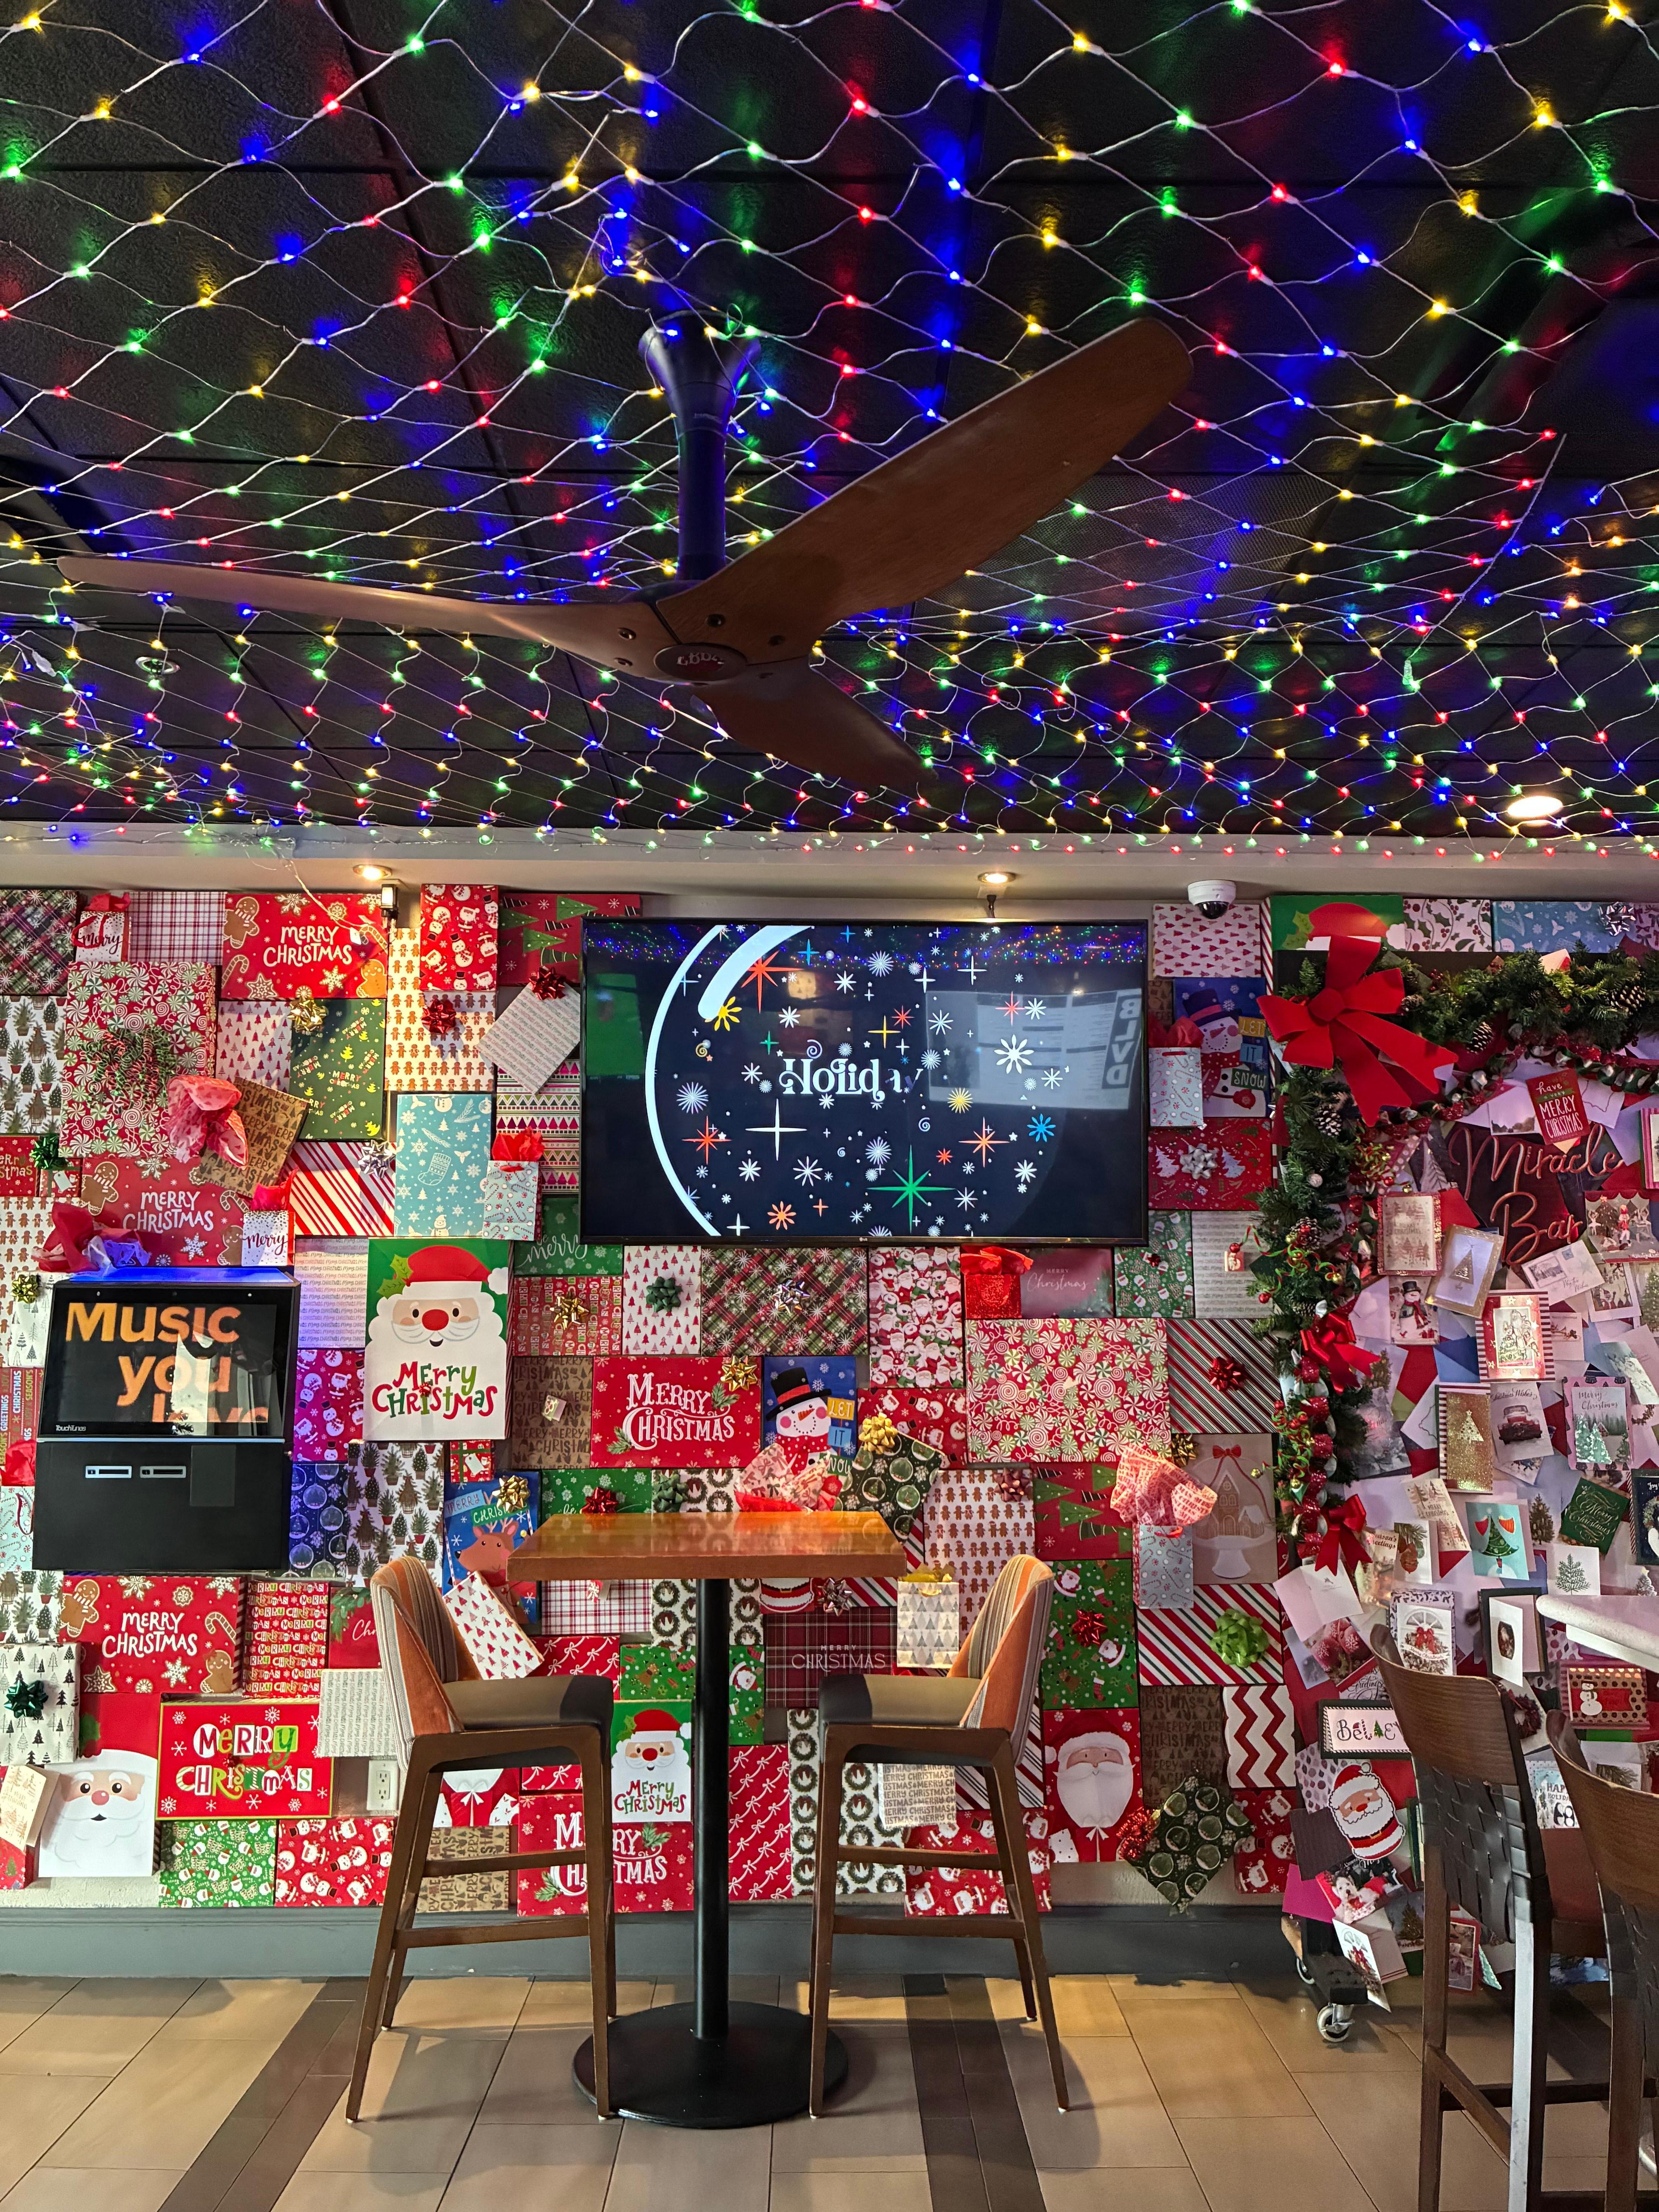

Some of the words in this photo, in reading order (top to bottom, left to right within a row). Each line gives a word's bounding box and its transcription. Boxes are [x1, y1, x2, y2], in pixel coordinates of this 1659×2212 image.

[281, 926, 339, 944] MERRY
[263, 942, 352, 967] CHRISTMAS
[1241, 1019, 1263, 1035] LET
[1245, 1047, 1257, 1060] IT
[1234, 1072, 1267, 1089] SNOW
[1536, 1082, 1562, 1094] have
[1539, 1095, 1576, 1120] MERRY
[1545, 1112, 1583, 1138] CHRISTMAS
[141, 1191, 201, 1211] MERRY
[123, 1209, 213, 1233] CHRISTMAS
[1490, 1191, 1583, 1265] Bar
[1027, 1273, 1089, 1291] Christmas
[65, 1302, 241, 1343] Music
[13, 1370, 21, 1413] CHRISTMAS
[117, 1355, 232, 1407] you
[626, 1372, 711, 1415] MERRY
[1579, 1391, 1602, 1401] Merry
[829, 1399, 852, 1417] LET
[622, 1407, 735, 1451] CHRISTMAS
[835, 1429, 846, 1446] IT
[447, 1493, 480, 1514] MERRY
[121, 1612, 184, 1633] MERRY
[102, 1631, 198, 1658] CHRISTMAS
[792, 1654, 885, 1672] CHRISTMAS
